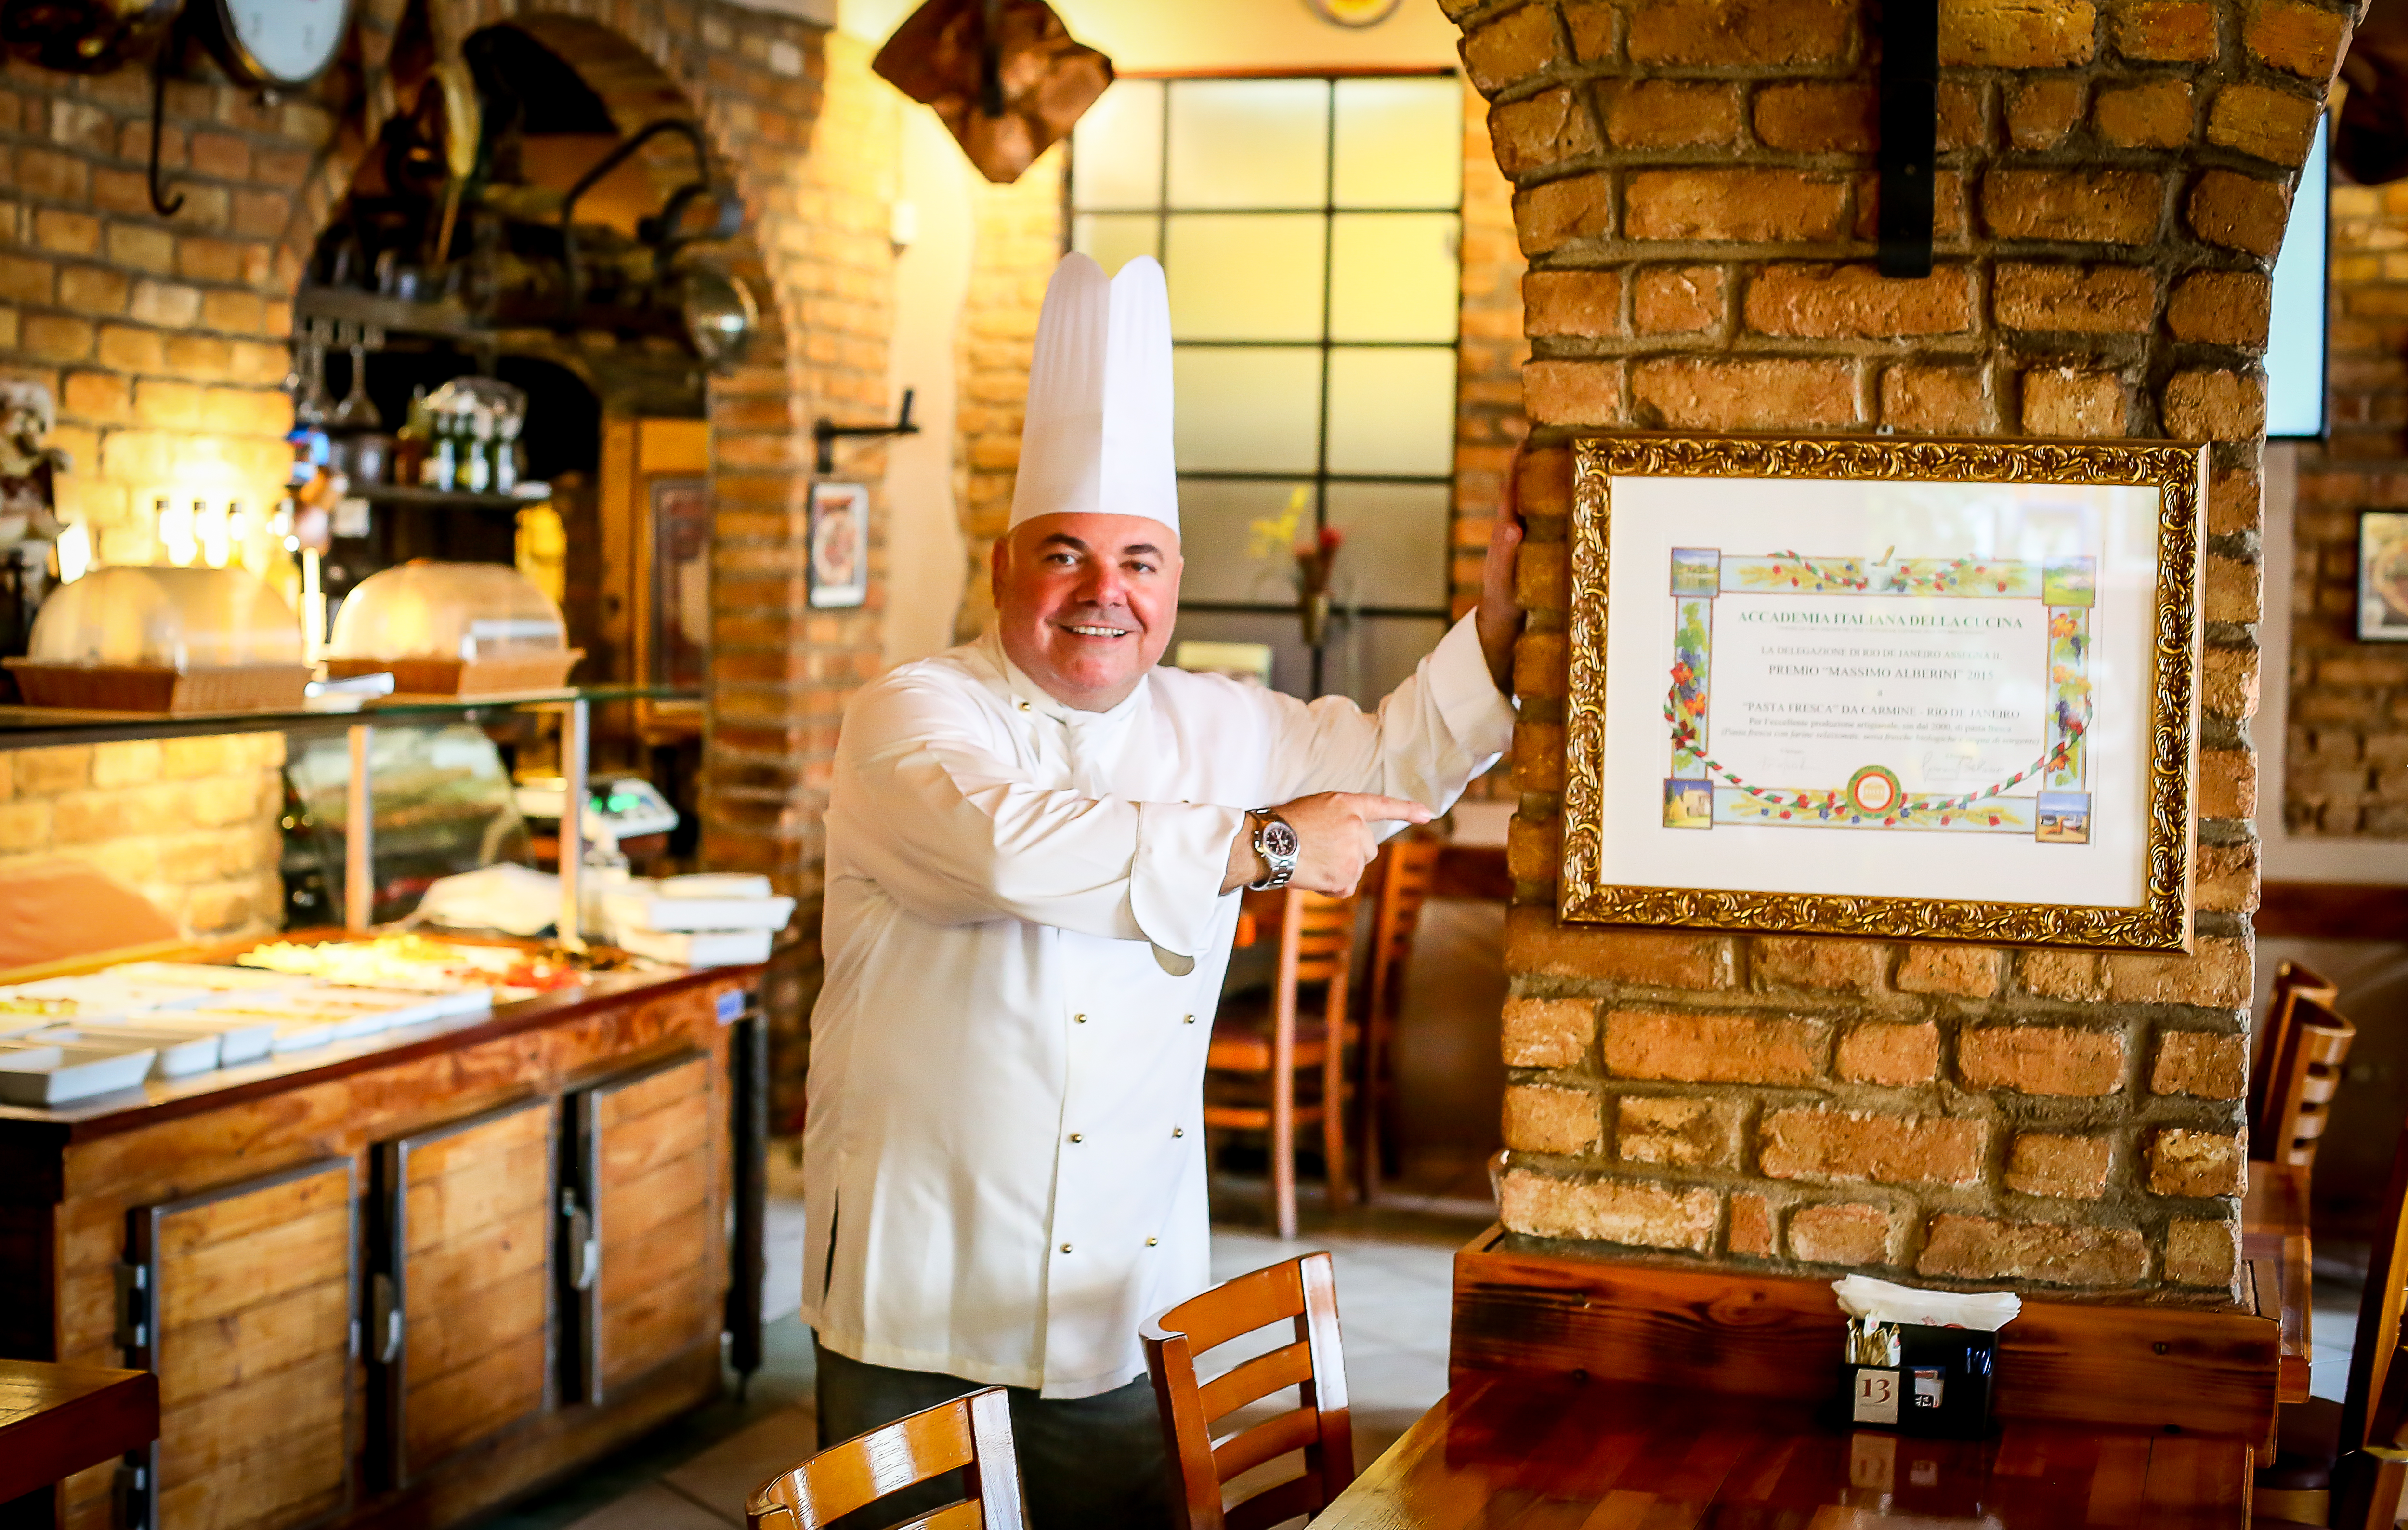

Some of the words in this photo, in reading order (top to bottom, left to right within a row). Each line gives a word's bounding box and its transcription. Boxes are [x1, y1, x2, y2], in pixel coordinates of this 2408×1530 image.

[1738, 611, 1830, 624] ACCADEMIA
[1834, 613, 1905, 626] ITALIANA
[1910, 615, 1959, 627] DELLA
[1963, 616, 2022, 629] CUCINA
[1761, 646, 1774, 655] LA
[1777, 646, 1846, 656] DELEGAZIONE
[1863, 648, 1880, 657] RIO
[1883, 648, 1894, 658] DE
[1899, 649, 1940, 659] JANEIRO
[1945, 650, 1989, 659] ASSEGNA
[1768, 664, 1819, 676] PREMIO
[1968, 670, 1993, 680] 2015
[1842, 705, 1857, 714] DA
[1861, 706, 1916, 716] CARMINE
[1927, 708, 1947, 716] RIO
[1951, 709, 1963, 717] DE
[1970, 709, 2020, 718] JANEIRO
[1862, 1378, 1892, 1404] 13
